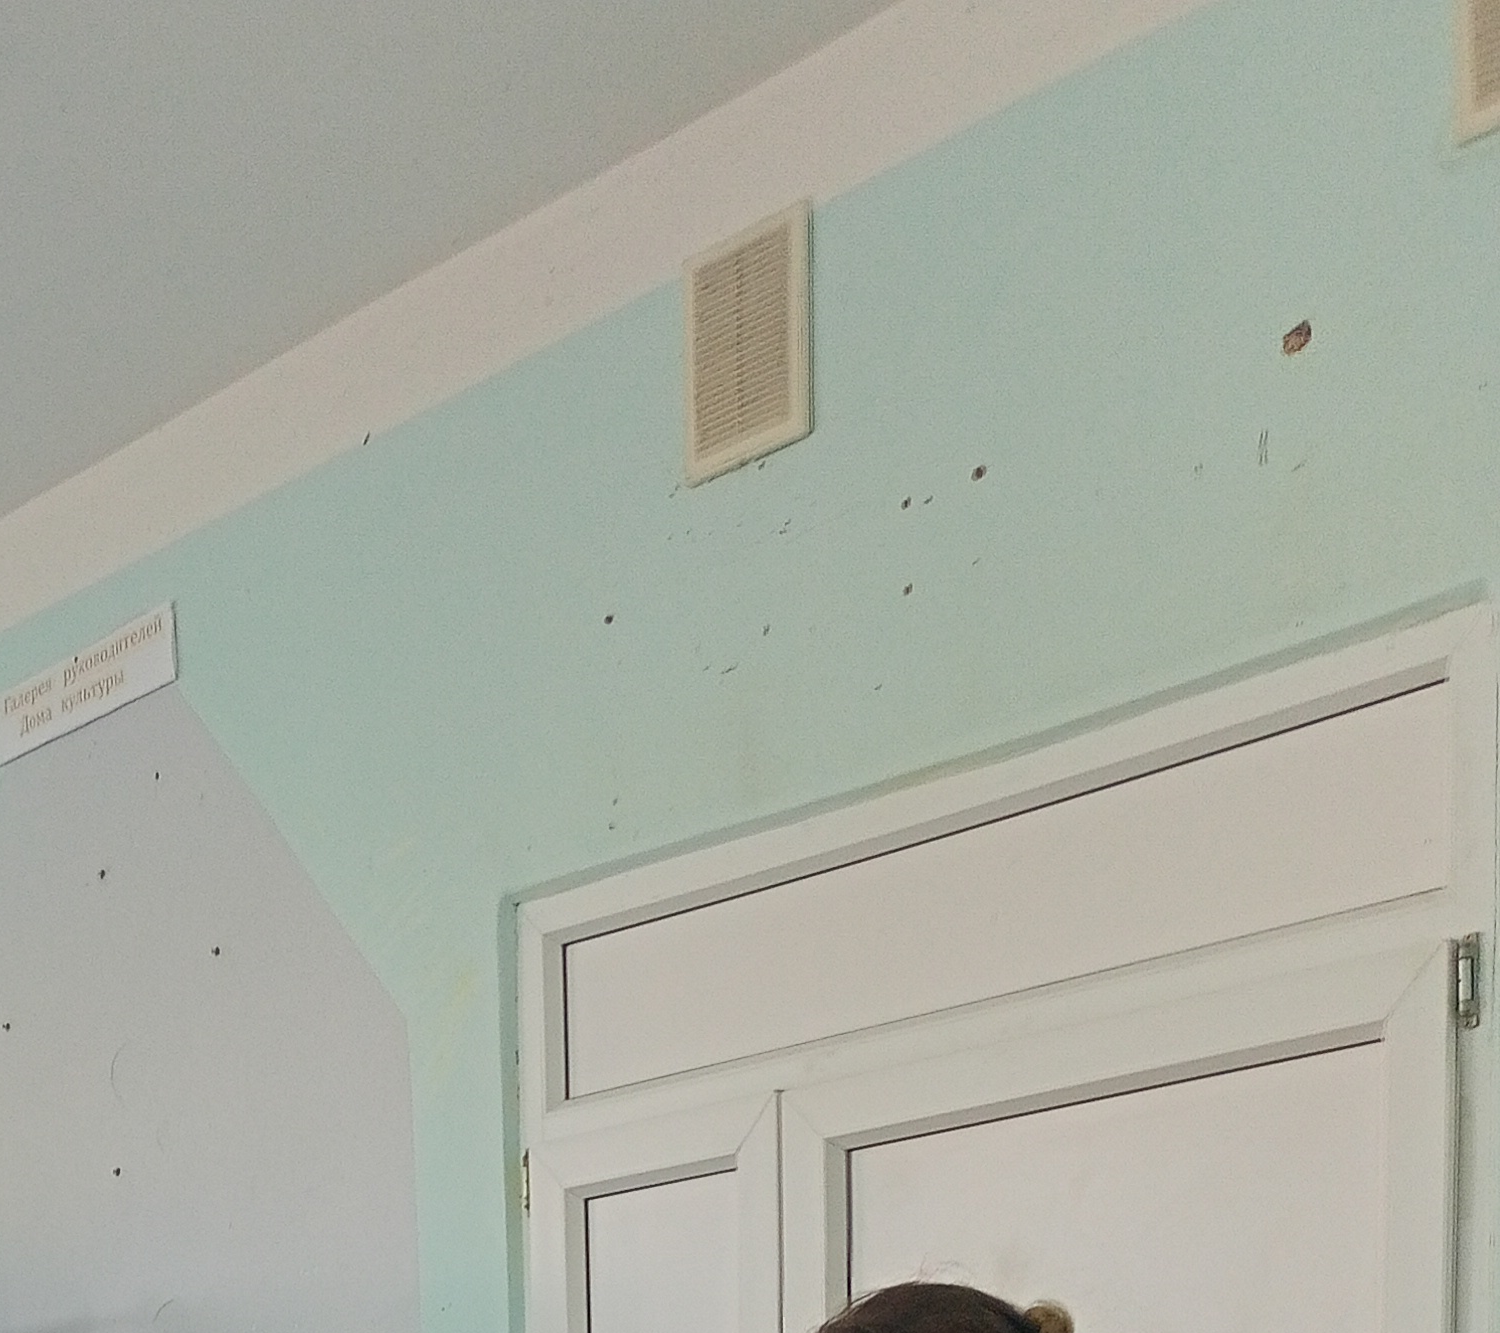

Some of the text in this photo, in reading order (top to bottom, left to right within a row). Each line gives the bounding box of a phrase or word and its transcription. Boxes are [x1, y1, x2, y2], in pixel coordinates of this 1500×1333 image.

[4, 613, 163, 715] Галерея руководителей
[20, 669, 125, 738] Дома культуры
